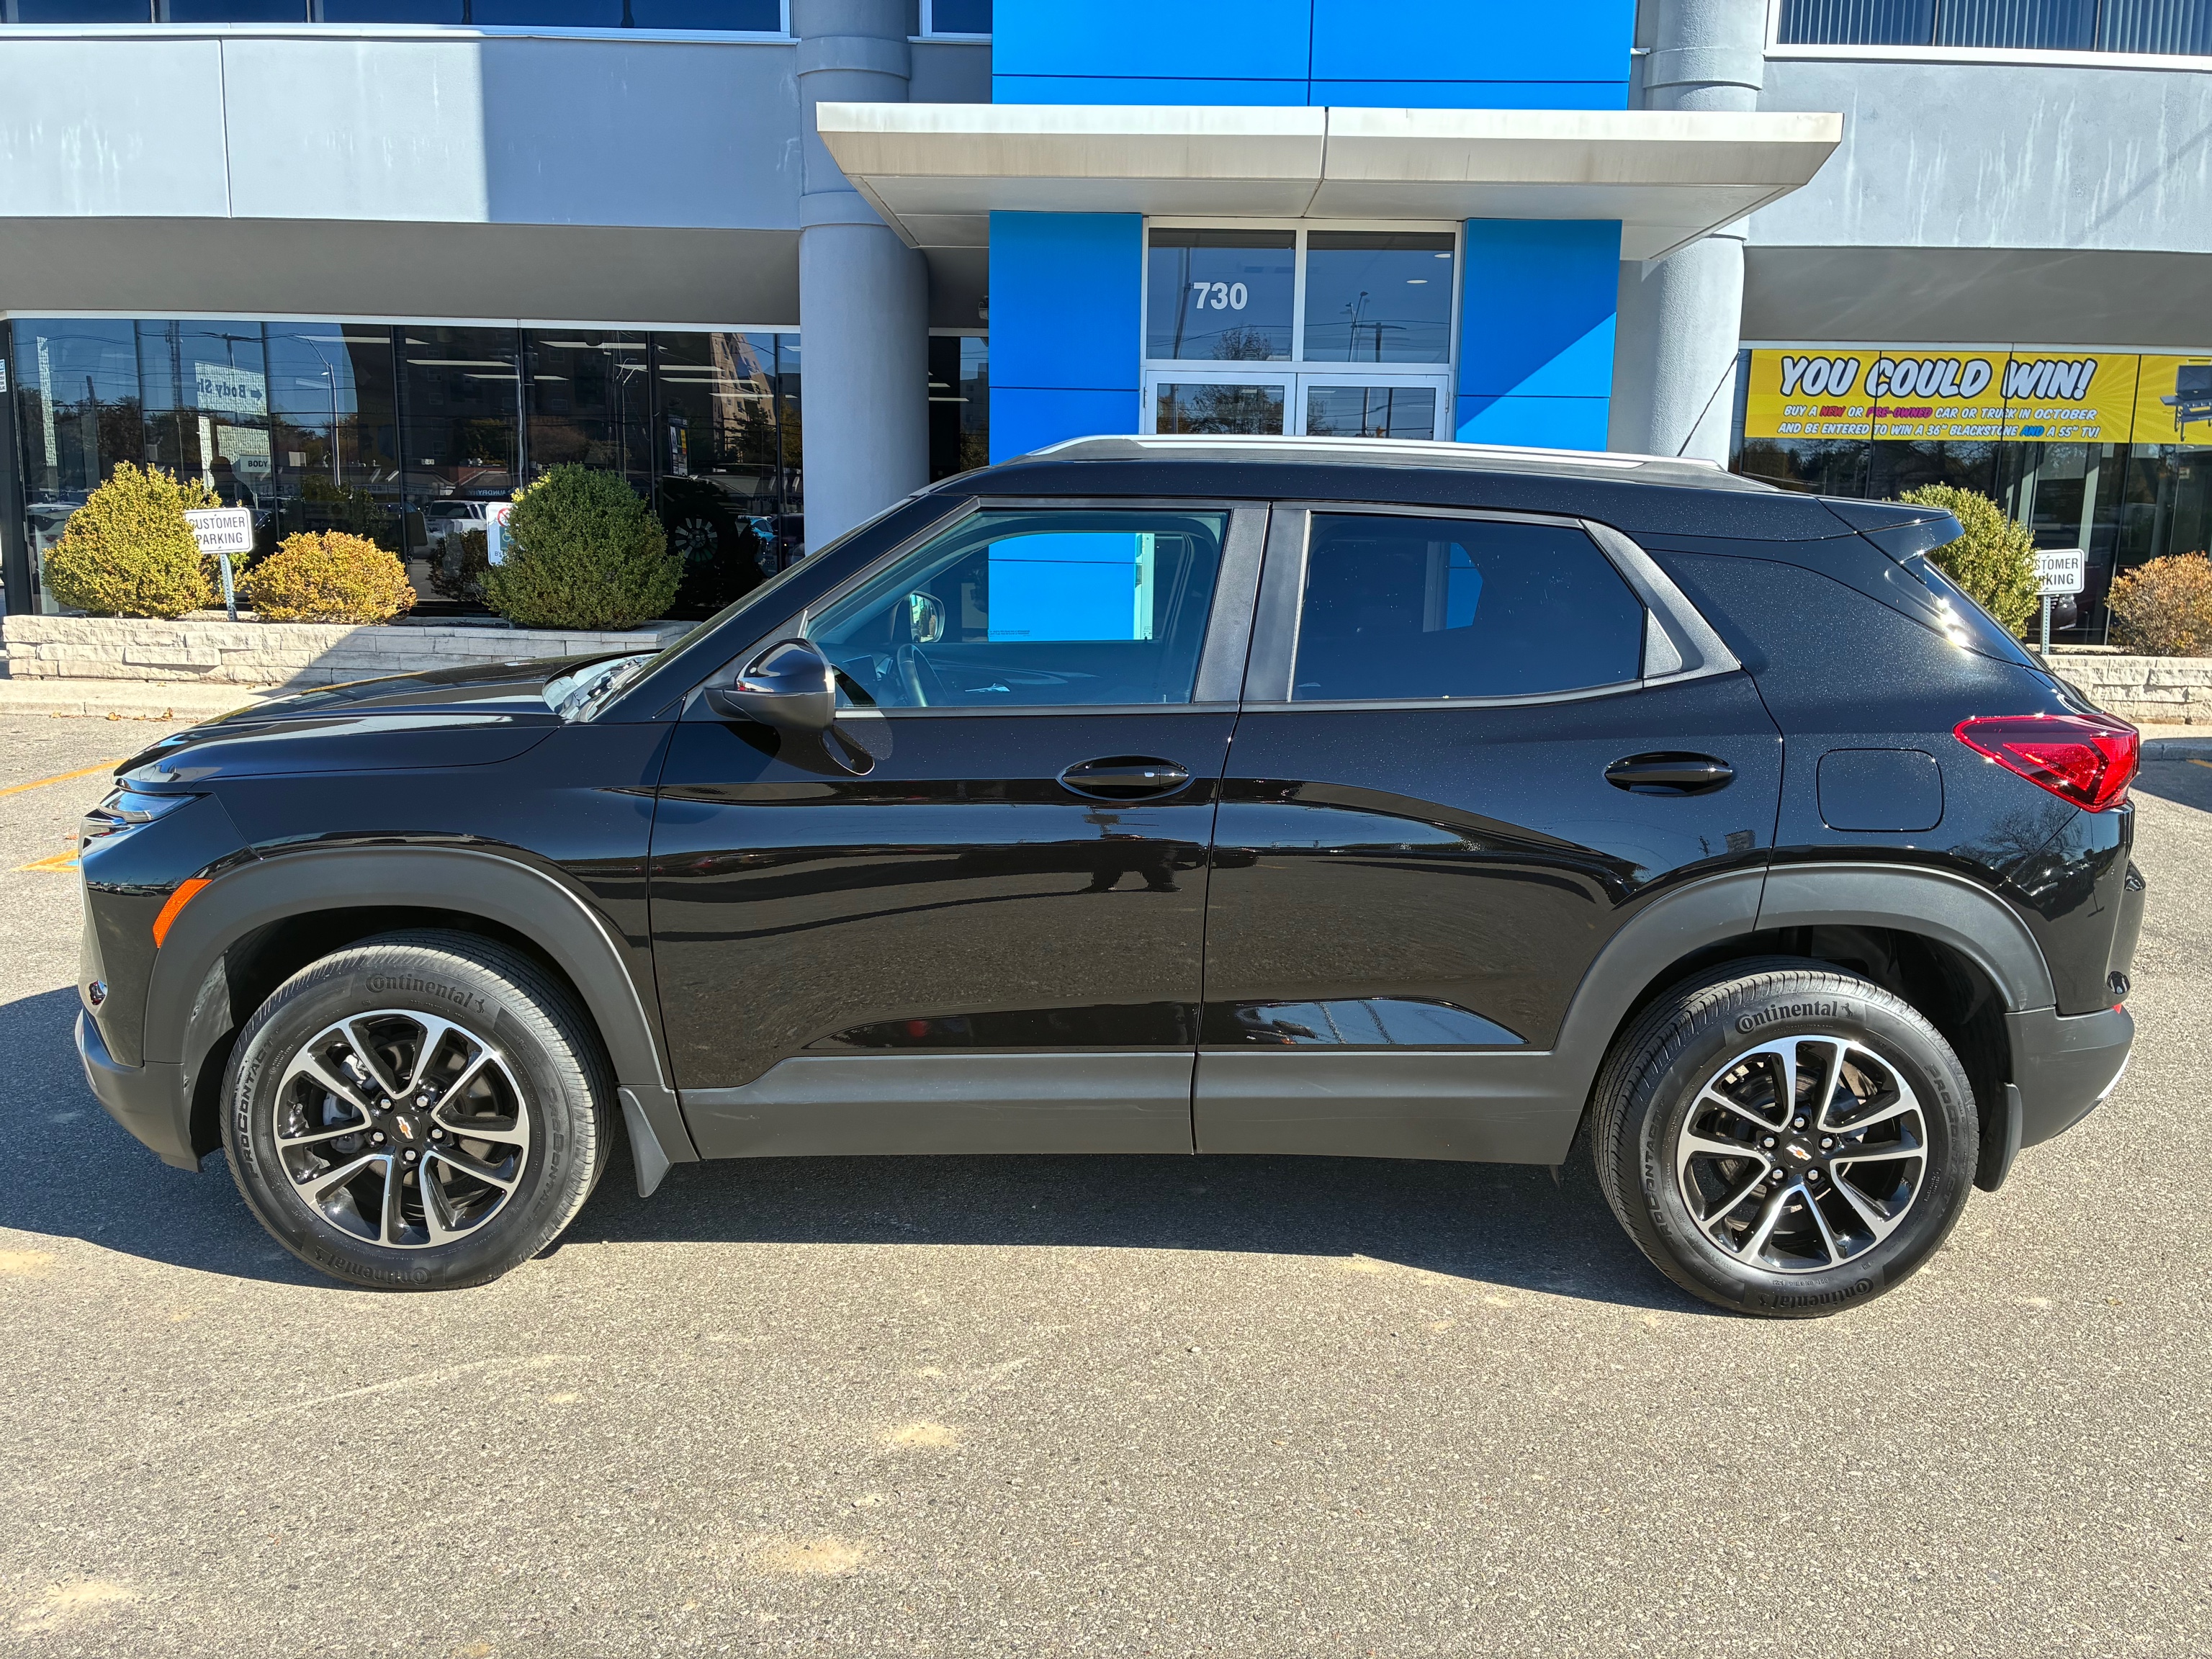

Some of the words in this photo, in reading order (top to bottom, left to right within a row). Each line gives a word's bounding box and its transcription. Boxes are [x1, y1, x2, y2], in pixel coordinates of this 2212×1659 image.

[1192, 282, 1248, 310] 730
[1780, 356, 1861, 397] YOU
[1864, 357, 1992, 398] COULD
[2000, 358, 2098, 400] WIN!
[1784, 405, 1807, 417] BUY
[1808, 405, 1818, 417] A
[1820, 405, 1846, 418] NEW
[1848, 405, 1863, 418] OR
[1866, 406, 1933, 418] PRE-OWNED
[1935, 407, 1959, 419] CAR
[1961, 407, 1978, 419] OR
[2018, 408, 2032, 420] IN
[2033, 408, 2098, 421] OCTOBER
[1777, 422, 1802, 434] AND
[1804, 423, 1820, 434] BE
[1821, 423, 1871, 436] ENTERED
[1873, 423, 1888, 436] TO
[1890, 423, 1914, 436] WIN
[1914, 423, 1923, 436] A
[1949, 424, 2019, 436] BLACKSTONE
[2019, 425, 2045, 437] AND
[2046, 426, 2055, 437] A
[2080, 426, 2101, 439] TV!
[188, 517, 246, 529] CUSTOMER
[196, 532, 243, 545] PARKING
[2033, 557, 2079, 570] STOMER
[2033, 573, 2074, 585] RKING
[366, 974, 474, 1008] Continental
[1735, 1001, 1838, 1035] Continental
[326, 1254, 432, 1285] Continental
[1771, 1277, 1874, 1309] Continental
